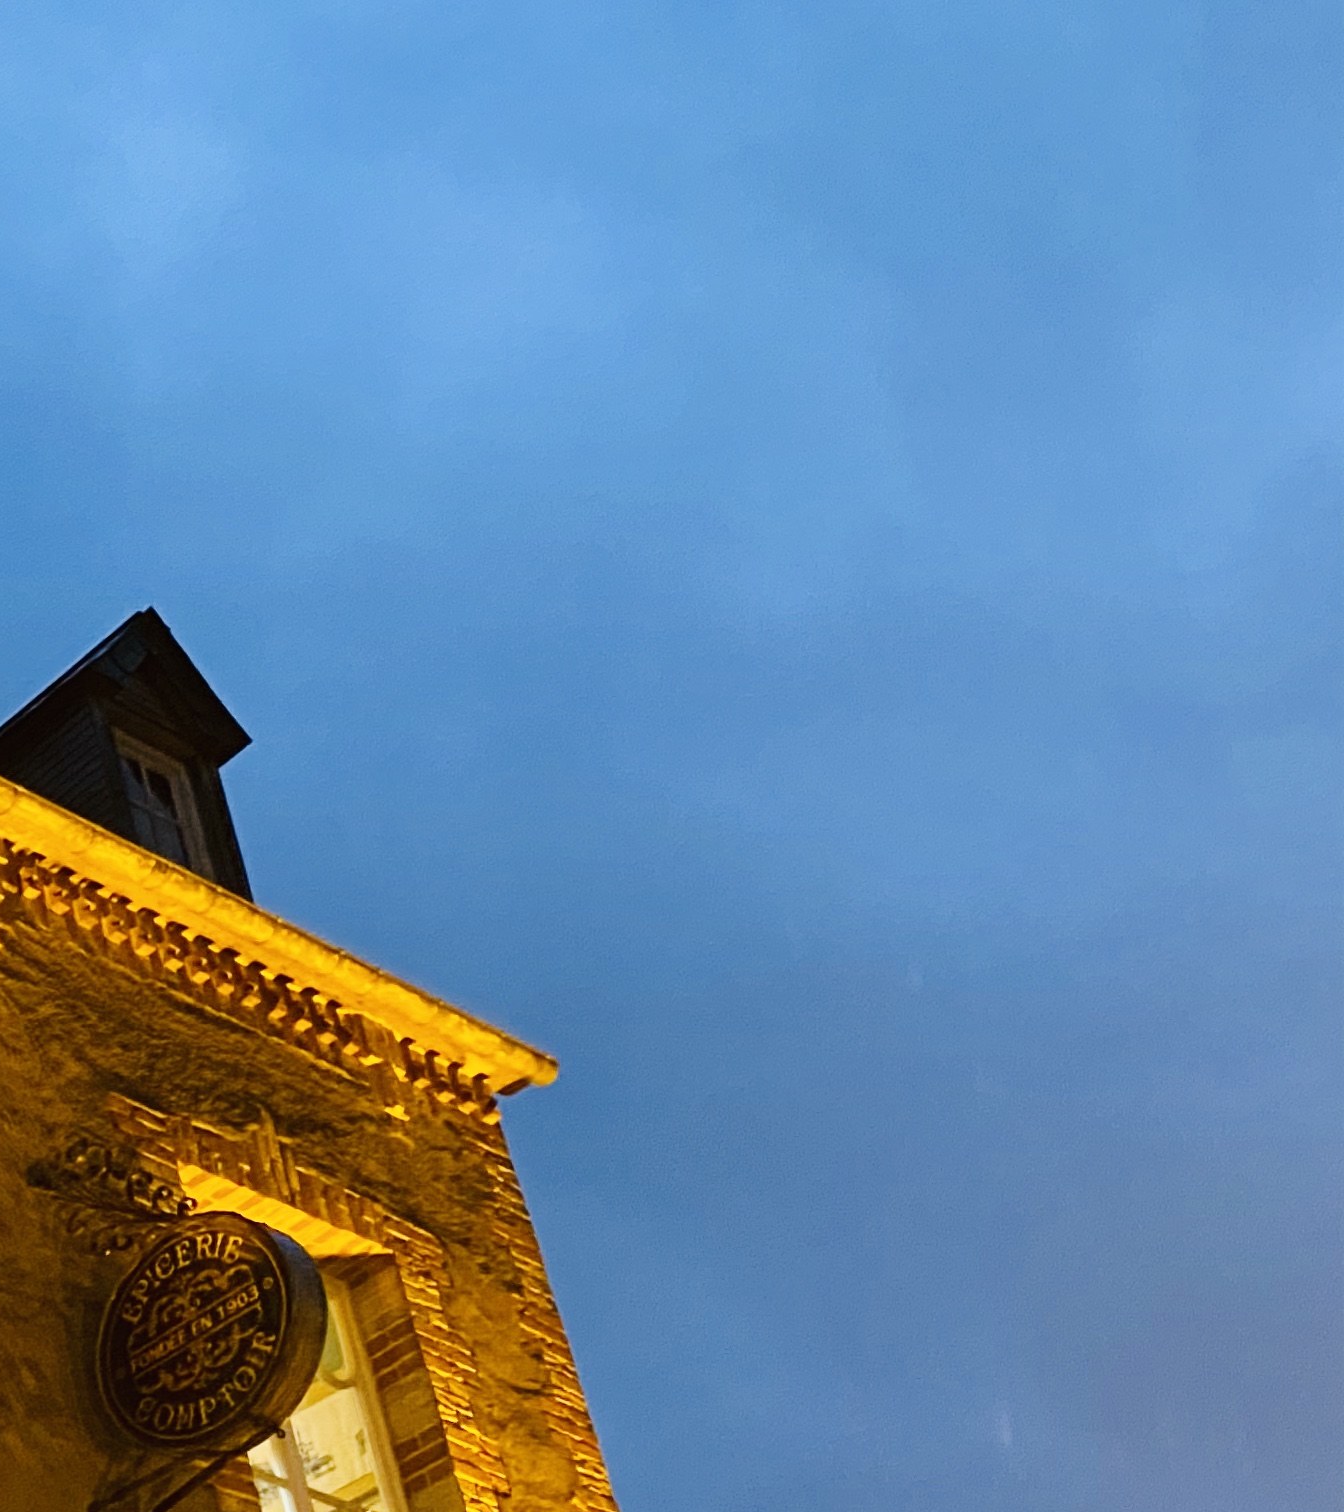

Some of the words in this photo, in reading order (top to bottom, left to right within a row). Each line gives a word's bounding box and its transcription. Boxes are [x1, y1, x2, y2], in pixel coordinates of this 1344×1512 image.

[122, 1231, 243, 1324] EPICERIE
[191, 1313, 213, 1336] EN
[217, 1284, 259, 1320] 1903
[135, 1331, 276, 1431] COMPTOIR
